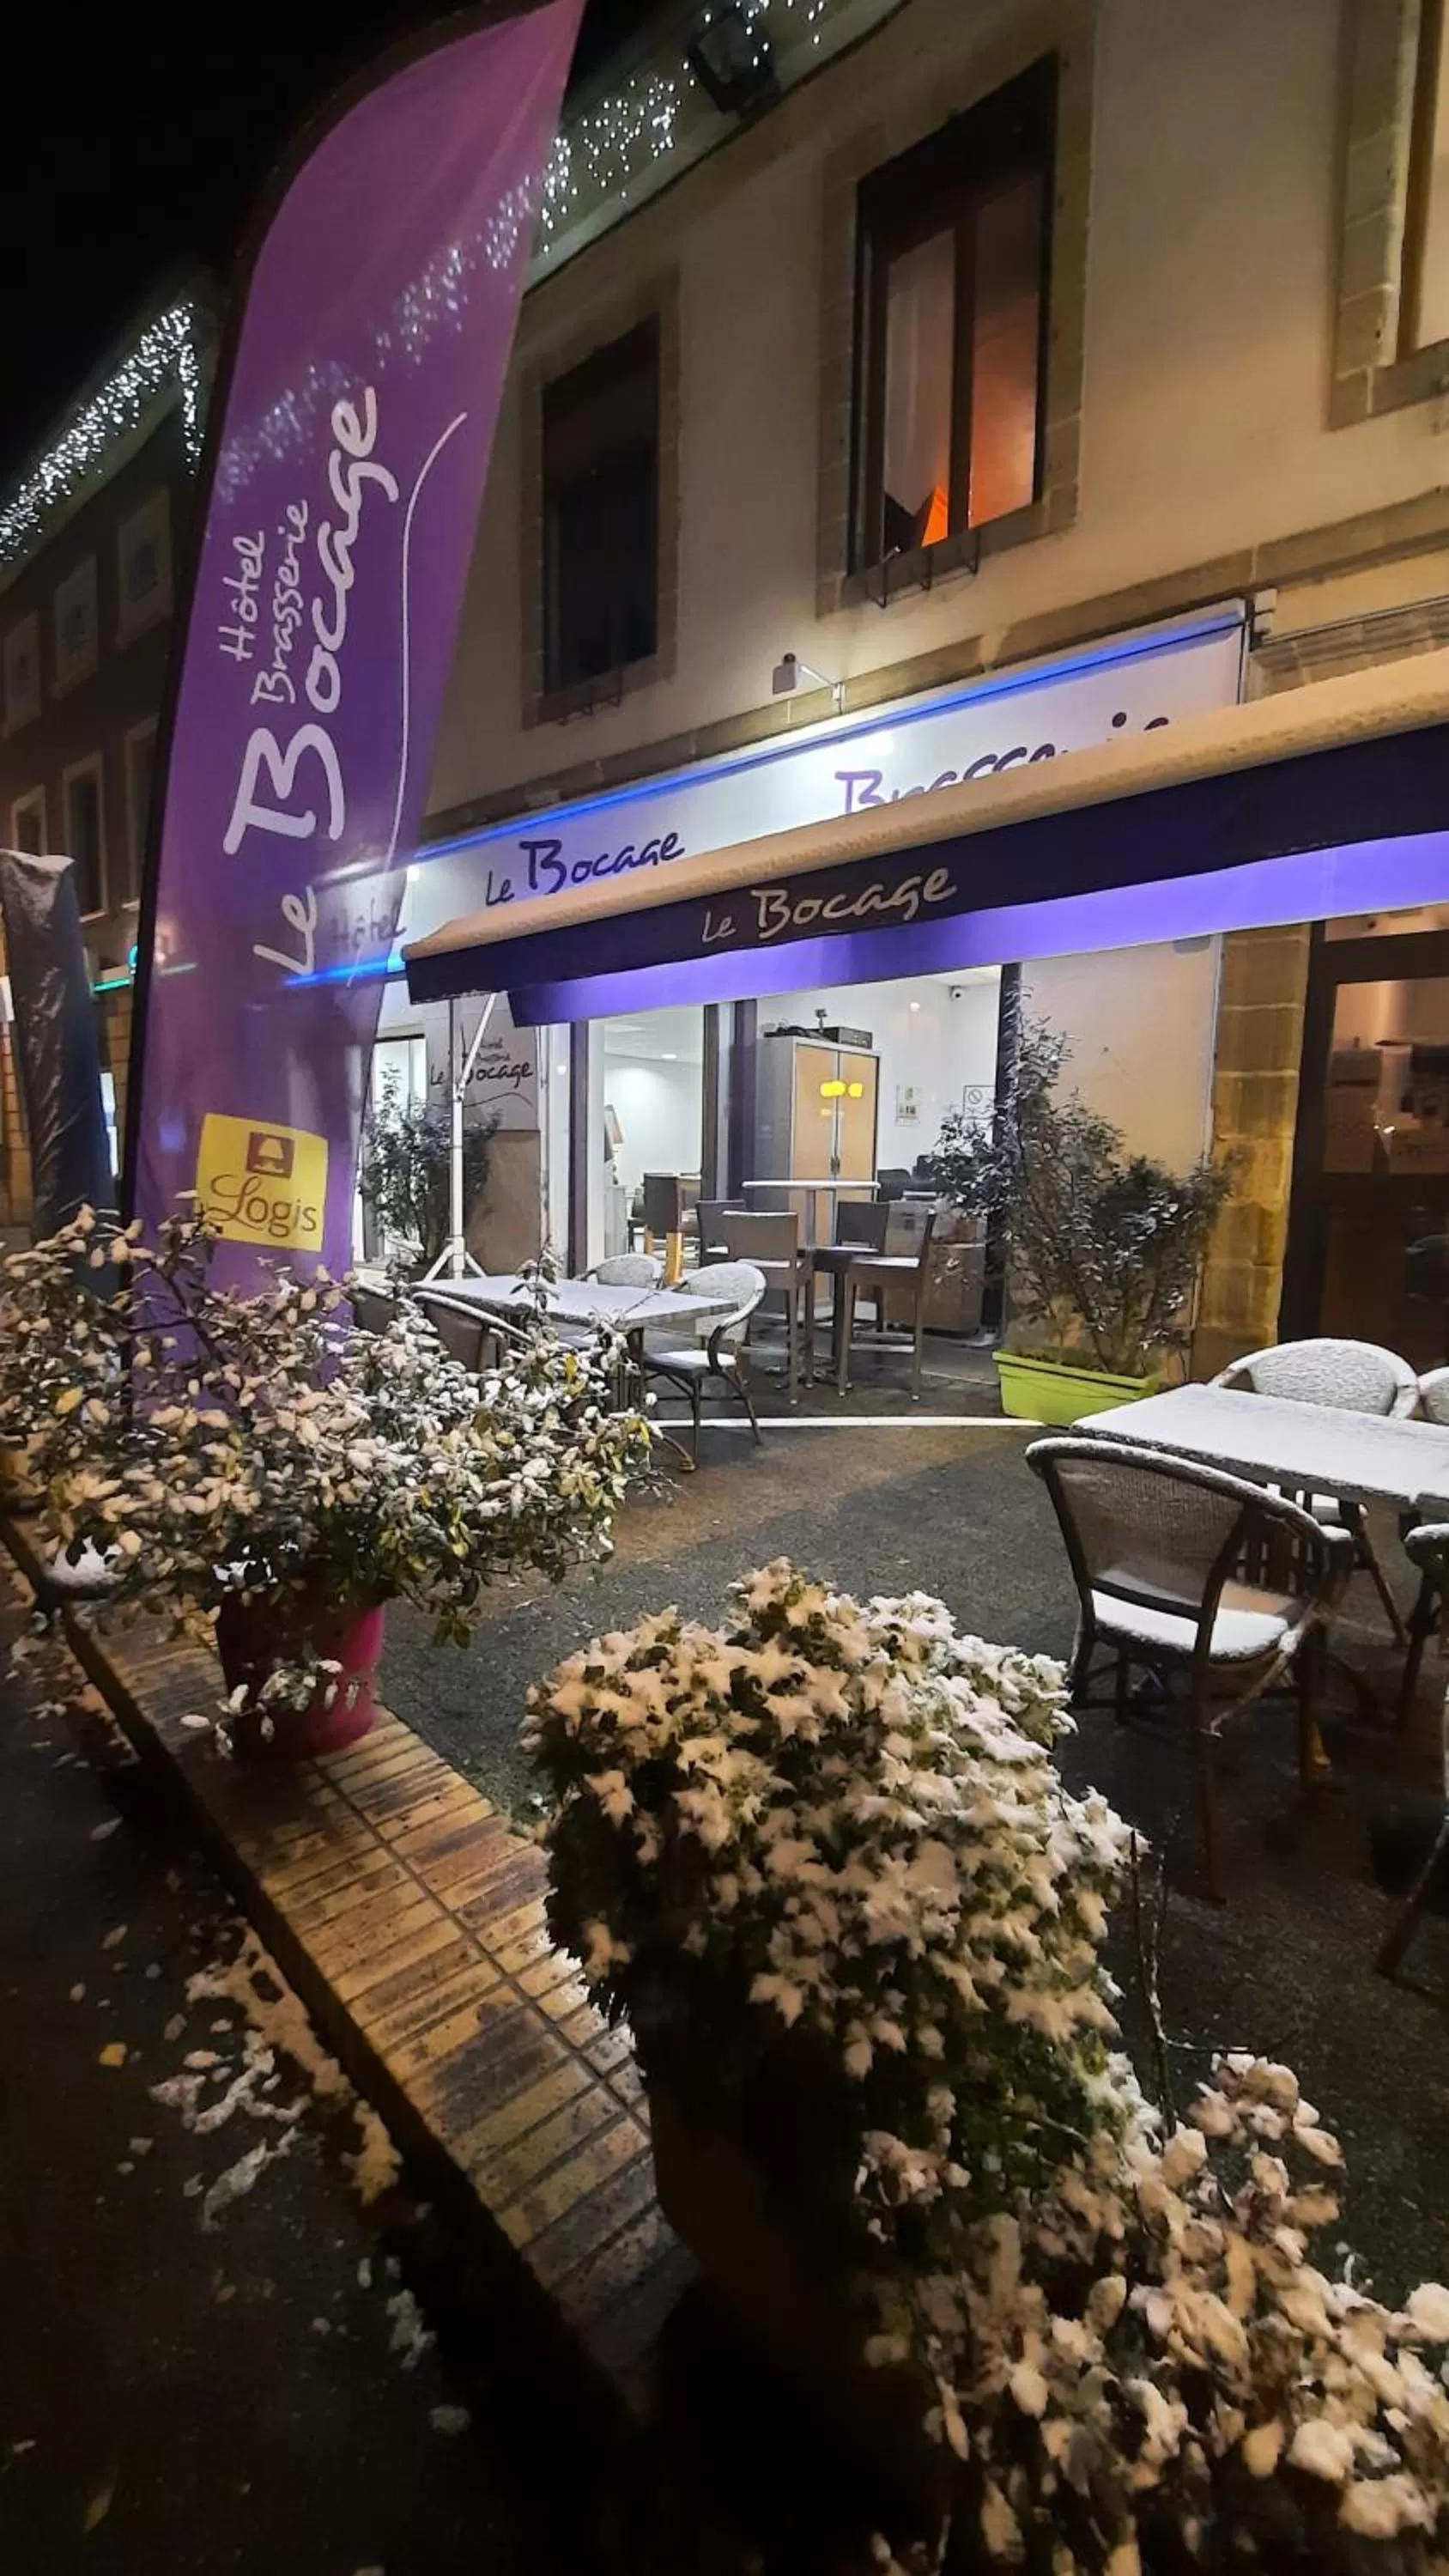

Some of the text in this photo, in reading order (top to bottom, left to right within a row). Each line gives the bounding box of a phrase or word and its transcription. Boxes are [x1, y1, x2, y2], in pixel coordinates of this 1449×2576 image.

[219, 530, 265, 662] Hôtel
[251, 498, 308, 704] Brasserie
[222, 386, 399, 975] Le Bocage
[485, 870, 515, 907] Le
[701, 866, 958, 944] Le Bocage
[206, 1173, 318, 1238] Logis
